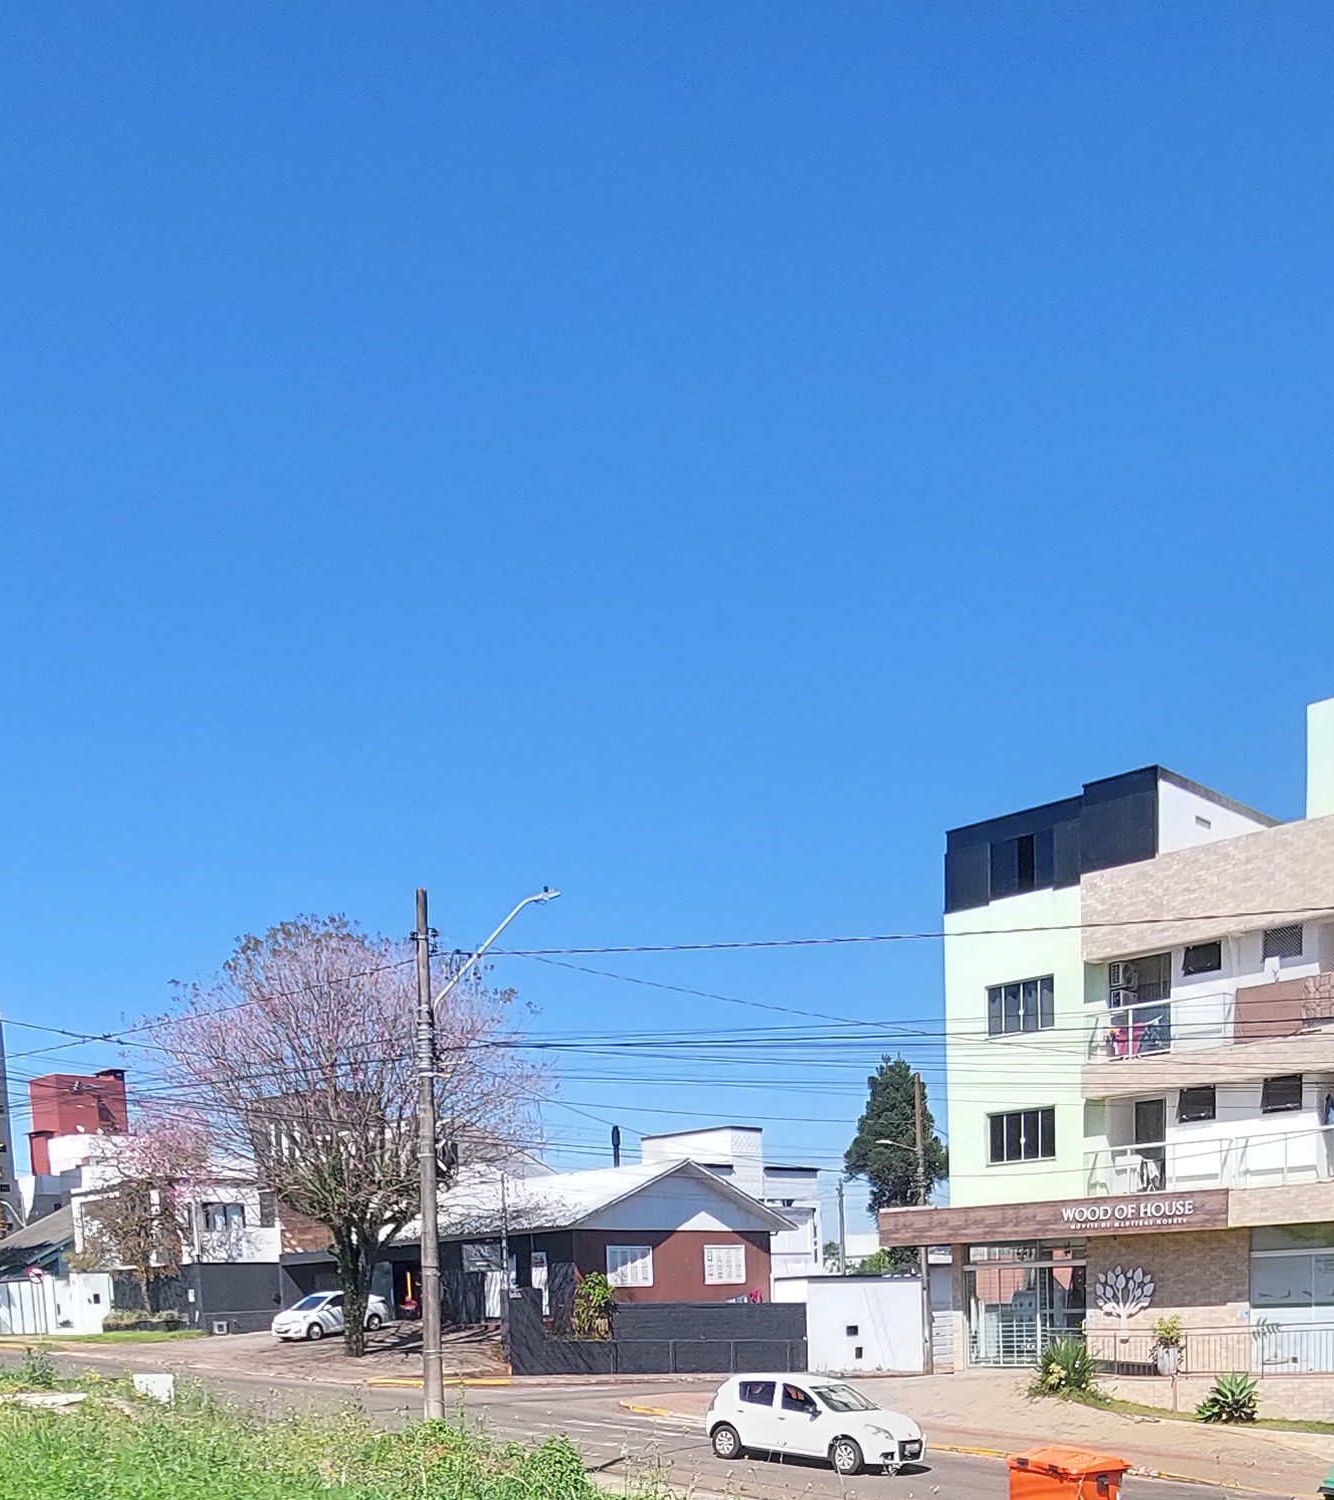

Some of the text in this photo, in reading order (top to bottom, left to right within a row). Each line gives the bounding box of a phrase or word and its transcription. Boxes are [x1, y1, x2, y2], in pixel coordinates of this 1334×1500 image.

[1061, 1200, 1194, 1221] WOOD OF HOUSE
